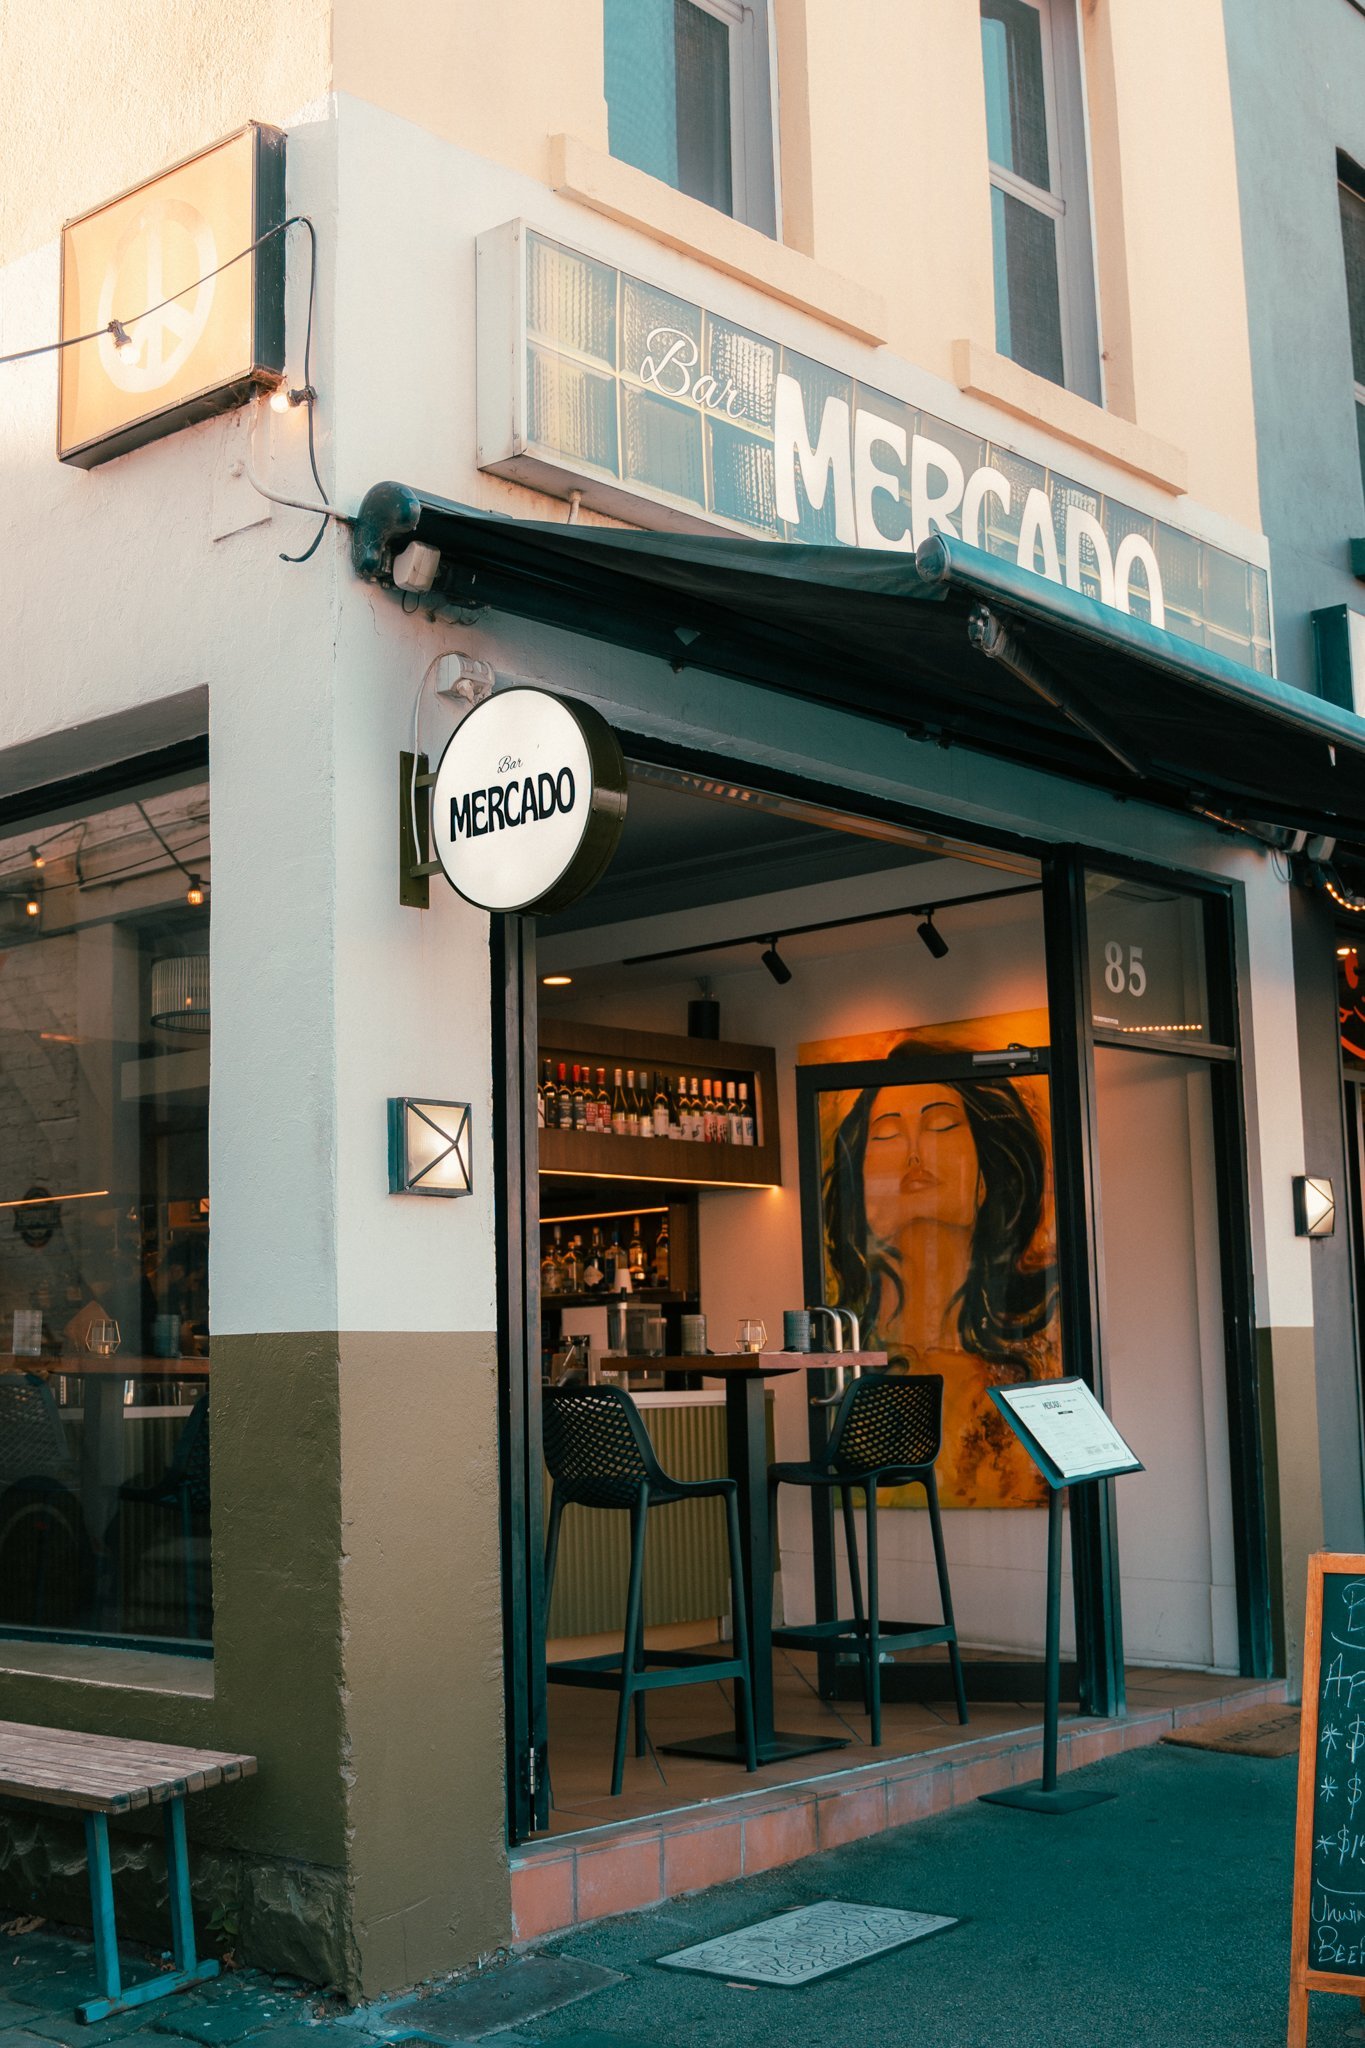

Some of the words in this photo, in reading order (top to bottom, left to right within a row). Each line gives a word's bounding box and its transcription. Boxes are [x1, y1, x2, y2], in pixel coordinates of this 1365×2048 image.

[639, 327, 746, 419] Bar
[774, 373, 1165, 630] MERCADO
[497, 755, 524, 774] Bar
[450, 766, 576, 842] MERCADO
[1104, 941, 1147, 997] 85
